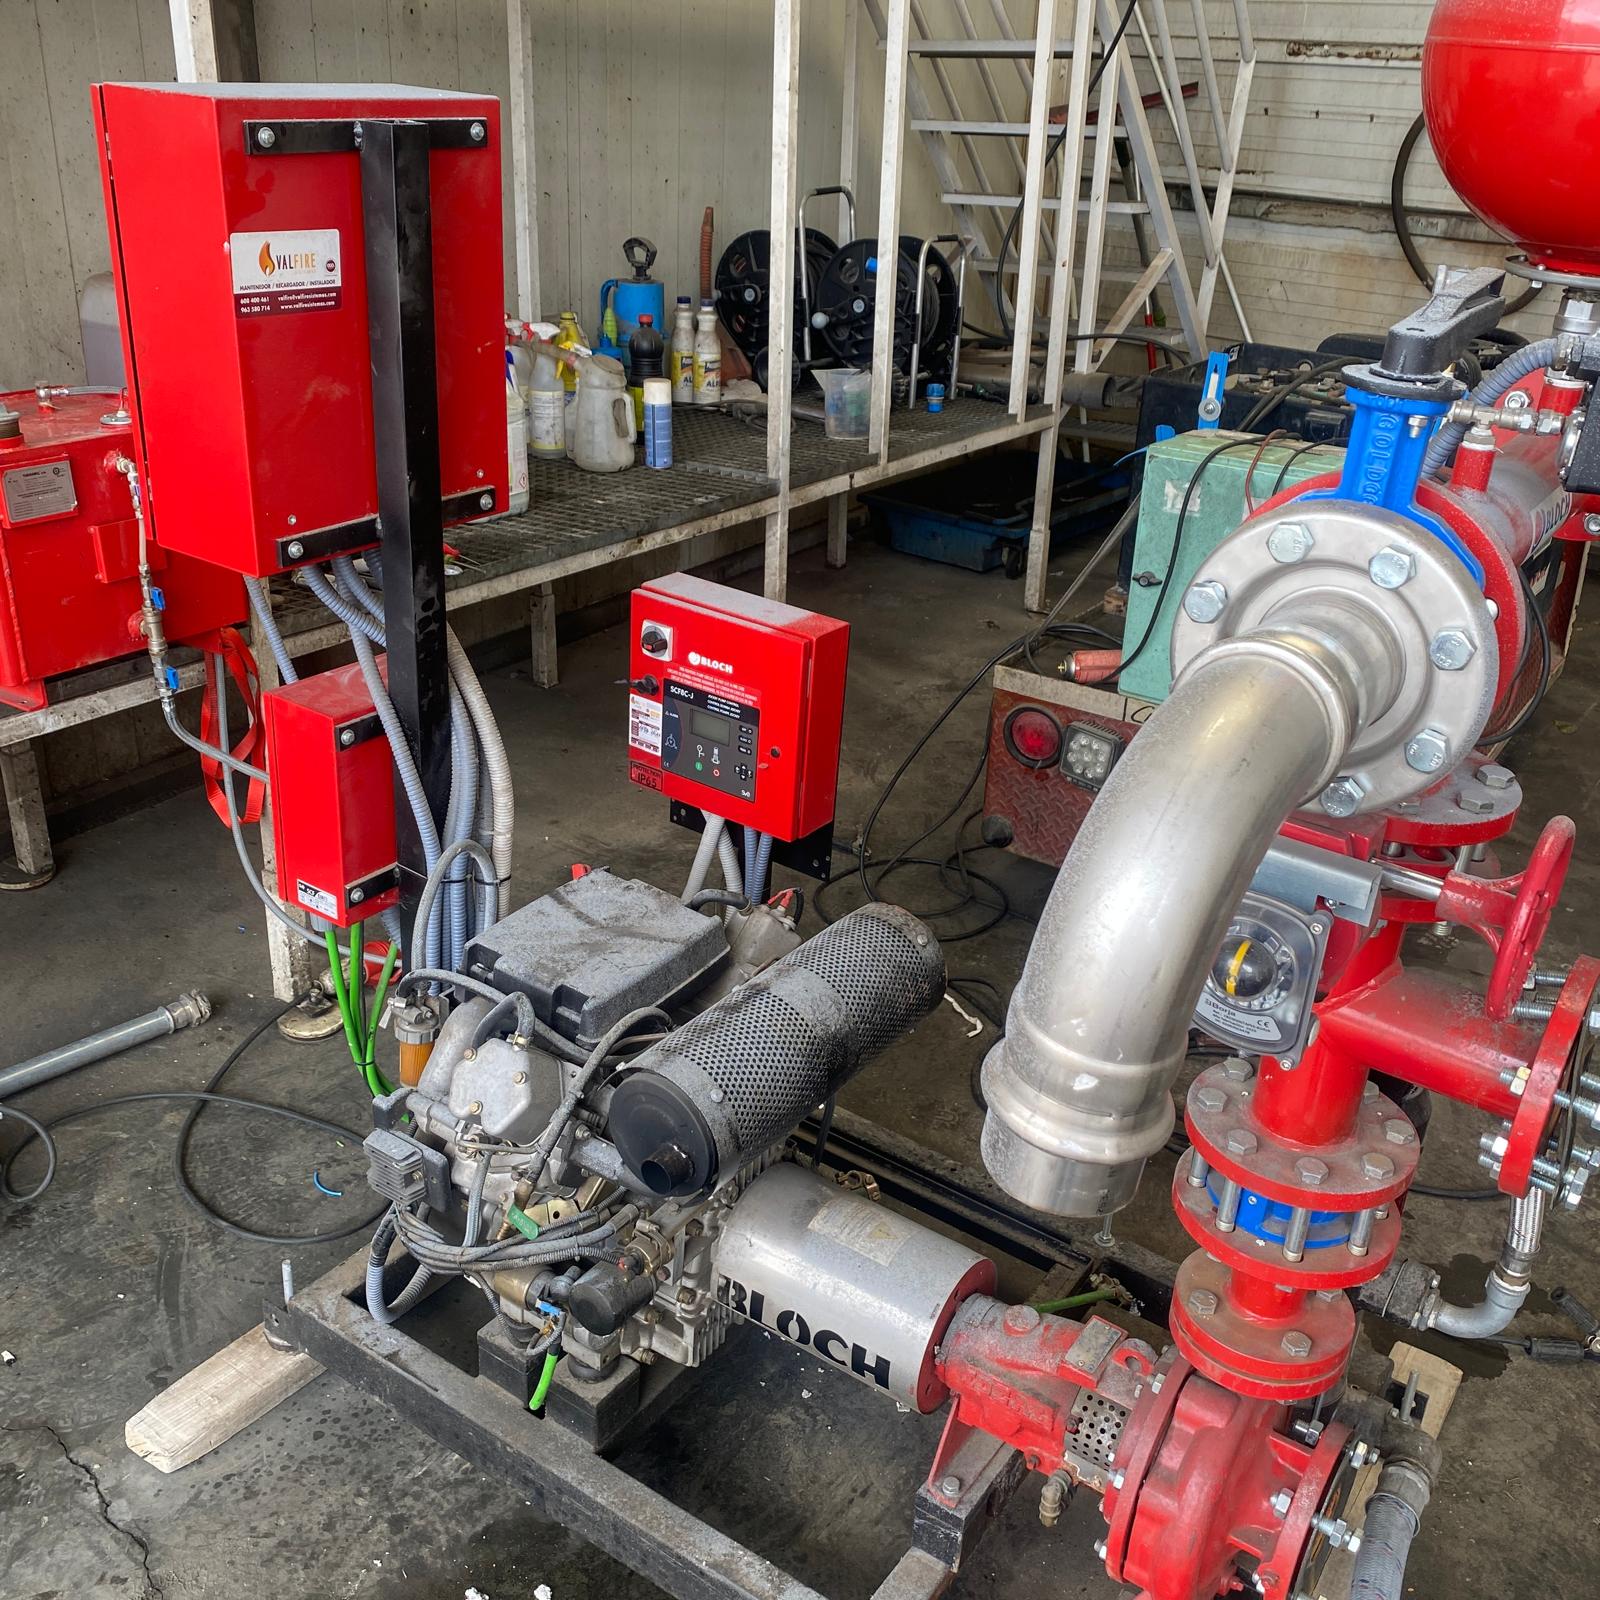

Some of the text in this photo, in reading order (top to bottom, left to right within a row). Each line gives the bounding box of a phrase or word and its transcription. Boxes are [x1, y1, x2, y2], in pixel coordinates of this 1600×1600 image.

[276, 254, 316, 270] VALFIRE
[701, 656, 733, 674] BLOCH
[638, 773, 657, 788] IP65
[717, 1273, 891, 1390] BLOCH
